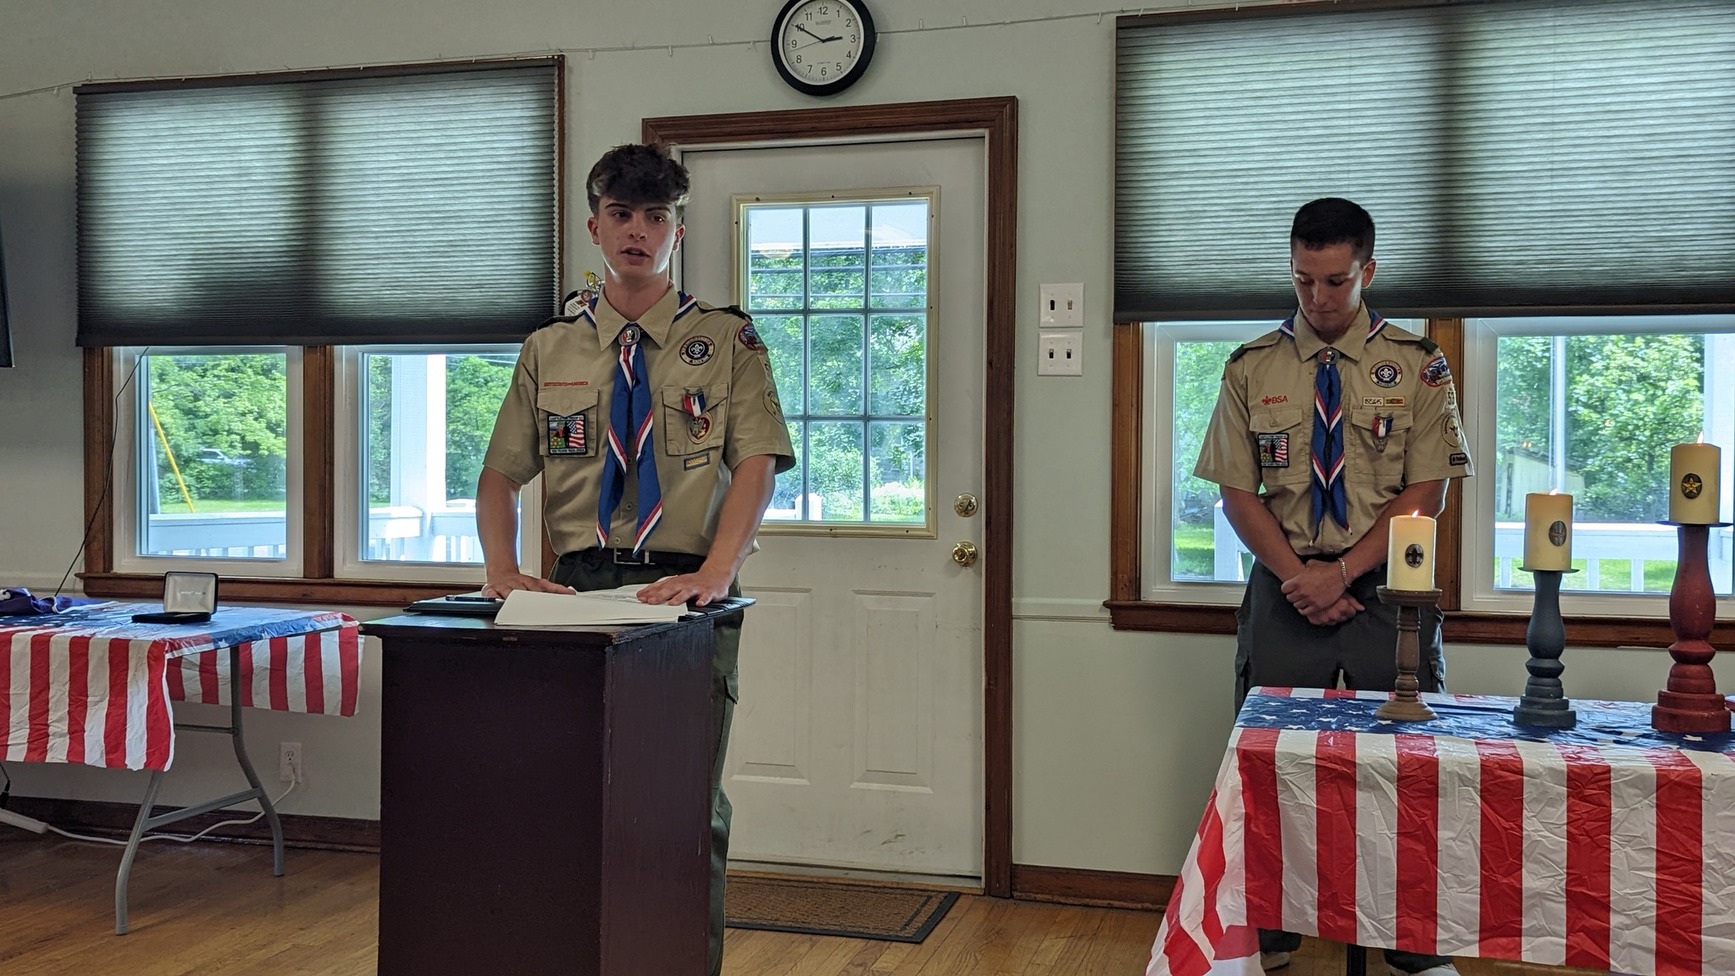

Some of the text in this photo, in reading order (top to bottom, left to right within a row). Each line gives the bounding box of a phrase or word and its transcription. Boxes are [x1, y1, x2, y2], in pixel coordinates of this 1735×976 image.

[818, 6, 828, 15] 12
[836, 9, 840, 18] 1
[805, 12, 813, 21] 11
[846, 19, 851, 27] 2
[850, 34, 856, 43] 3
[791, 39, 797, 48] 9
[846, 50, 851, 59] 4
[796, 55, 802, 64] 8
[807, 65, 812, 73] 7
[836, 62, 842, 71] 5
[821, 67, 827, 76] 6
[1271, 395, 1289, 404] BSA
